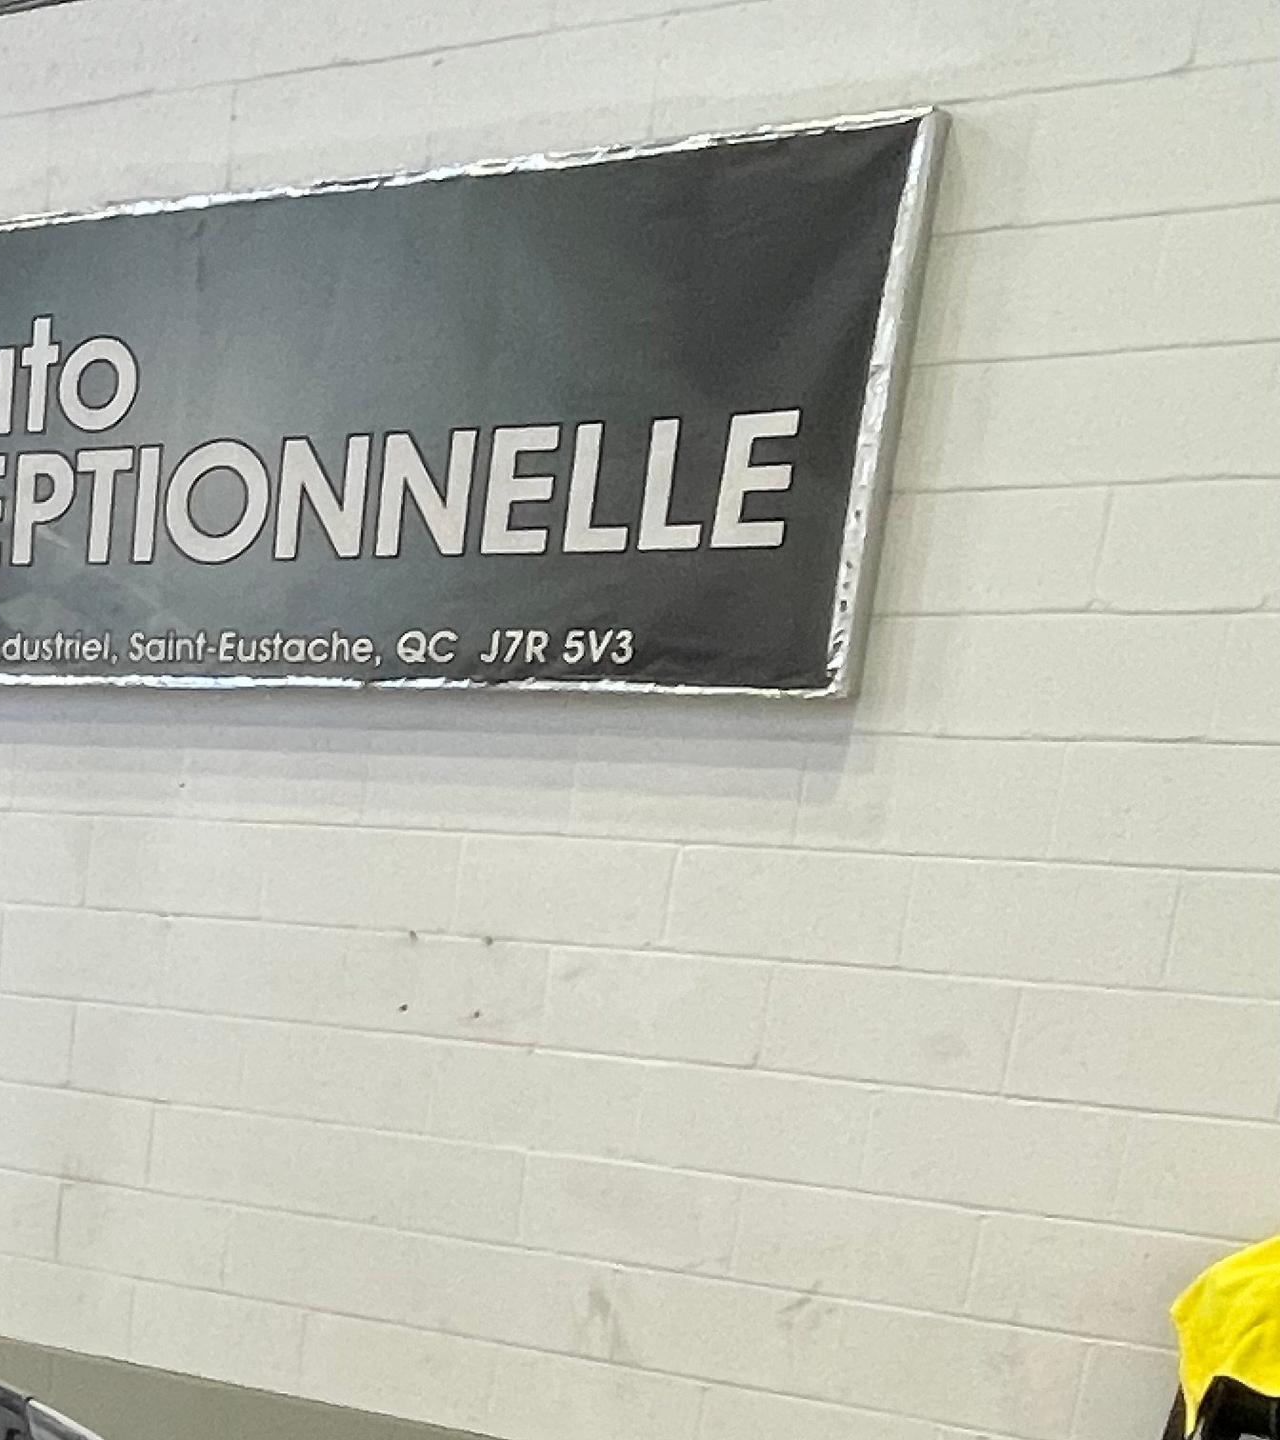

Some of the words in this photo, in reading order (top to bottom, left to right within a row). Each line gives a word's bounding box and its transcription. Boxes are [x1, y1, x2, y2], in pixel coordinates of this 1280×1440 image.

[127, 630, 382, 667] Saint-Eustache,
[395, 629, 460, 665] QC
[479, 628, 551, 664] J7R
[562, 628, 635, 666] 5V3
